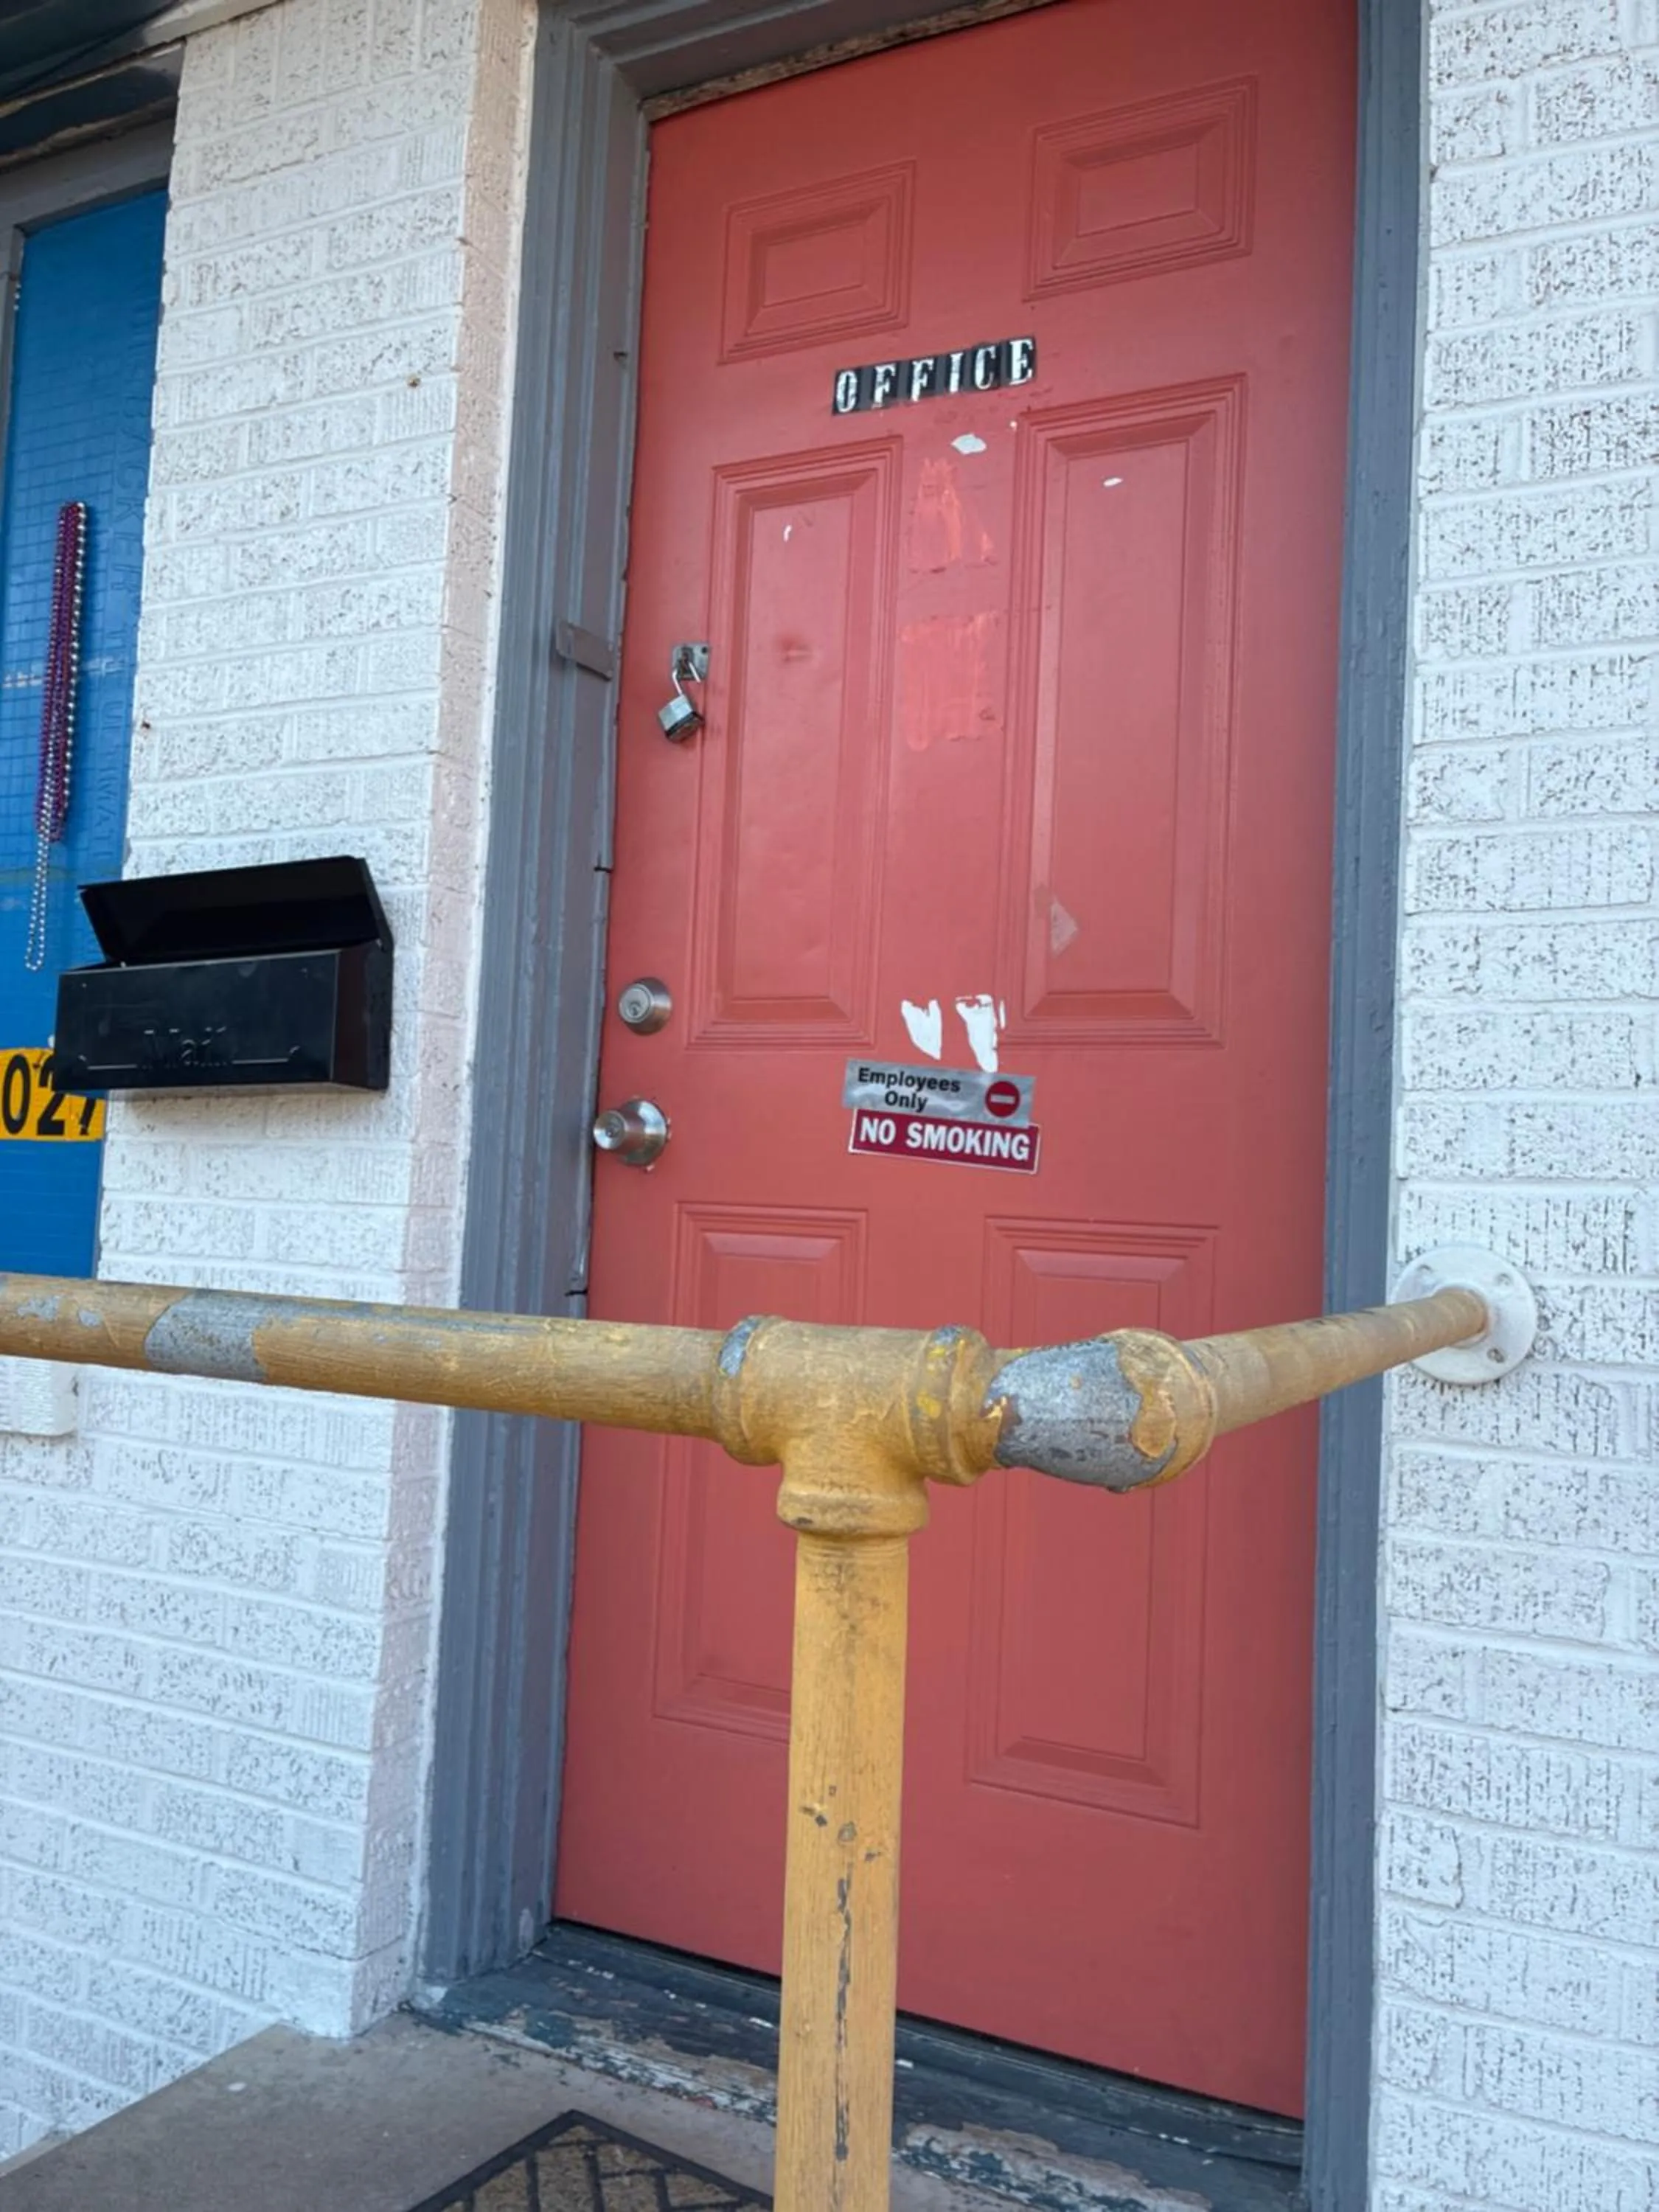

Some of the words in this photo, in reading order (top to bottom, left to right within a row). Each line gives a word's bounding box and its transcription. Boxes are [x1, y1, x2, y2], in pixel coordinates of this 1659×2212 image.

[835, 338, 1034, 413] OFFICE
[858, 1067, 961, 1093] Employees
[884, 1091, 928, 1113] Only
[860, 1116, 896, 1144] NO
[906, 1122, 1030, 1161] SMOKING
